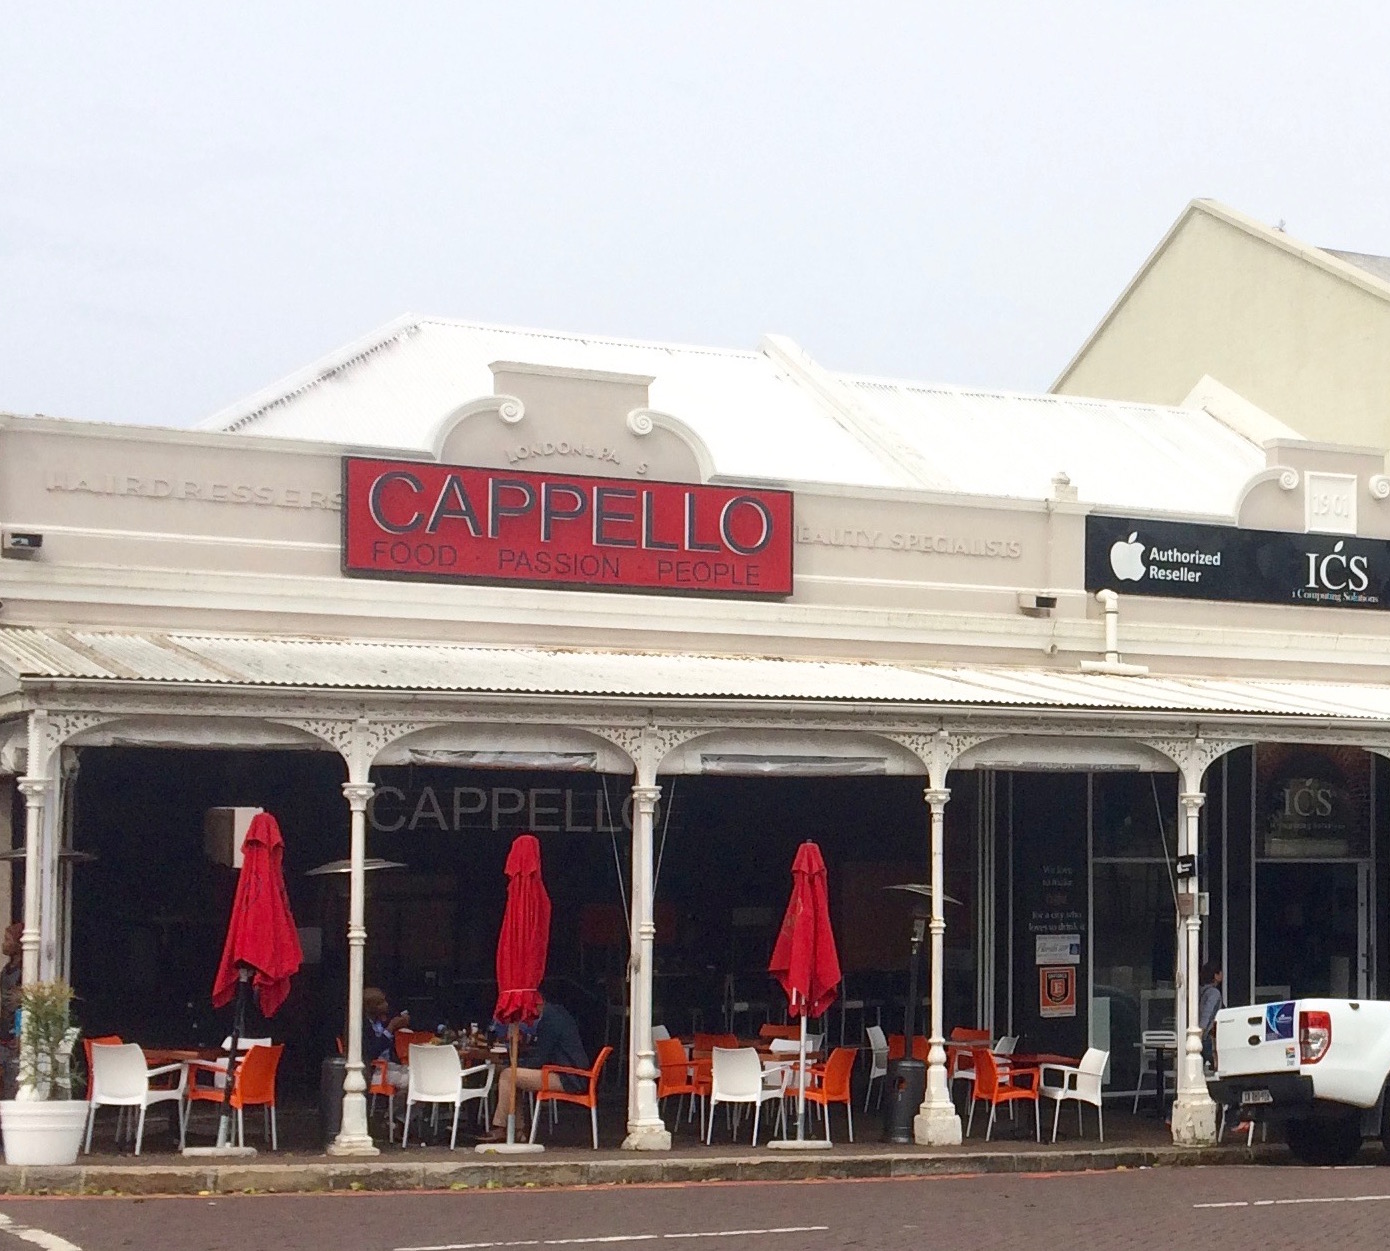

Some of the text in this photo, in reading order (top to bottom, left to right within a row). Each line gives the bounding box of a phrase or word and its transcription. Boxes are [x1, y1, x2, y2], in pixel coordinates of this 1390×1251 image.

[46, 470, 345, 512] HAIRDRESSERS
[368, 470, 774, 556] CAPPELLO
[890, 532, 1022, 560] SPECIALISTS
[1149, 546, 1221, 567] Authorized
[372, 540, 761, 587] FOOD PASSION PEOPLE
[1149, 565, 1202, 583] Reseller
[1304, 552, 1369, 592] ICS
[1297, 588, 1342, 603] Computing
[1342, 591, 1379, 603] Solutions
